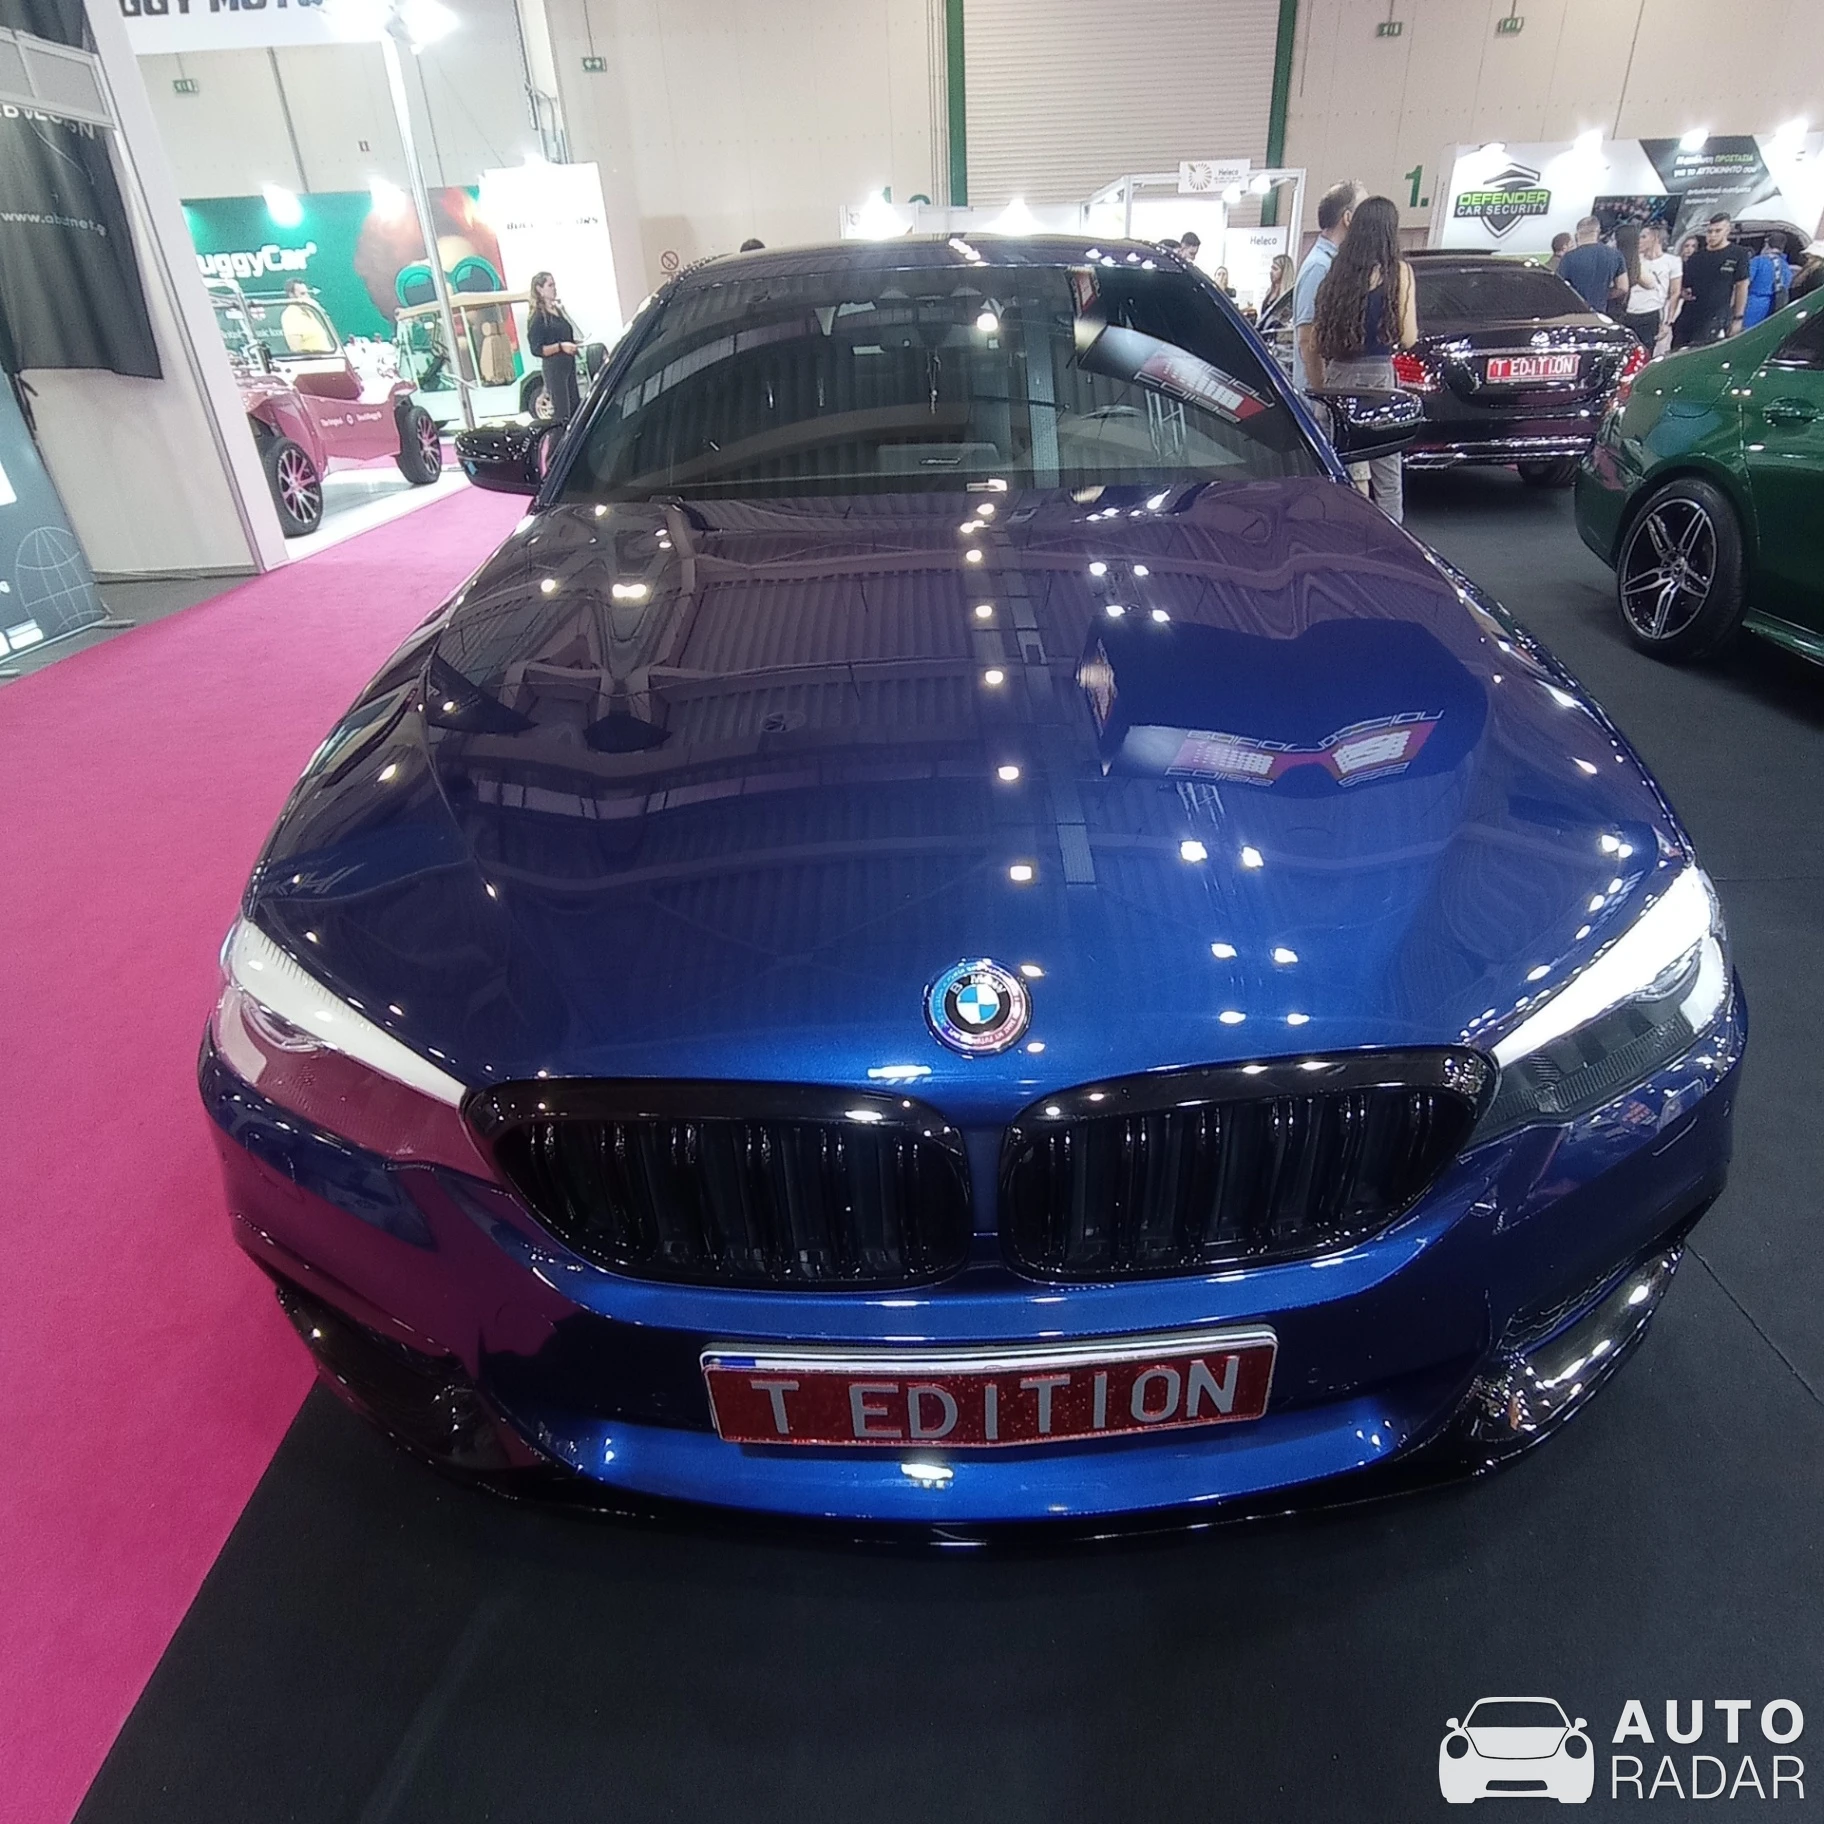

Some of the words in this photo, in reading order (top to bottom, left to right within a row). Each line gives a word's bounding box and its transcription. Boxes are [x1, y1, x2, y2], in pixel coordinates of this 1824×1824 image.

[1458, 191, 1549, 206] DEFENDER
[1457, 205, 1482, 216] CAR
[1485, 203, 1548, 216] SECURITY
[1250, 235, 1278, 246] Heleco
[1510, 356, 1574, 376] EDITION
[750, 1380, 799, 1434] T
[848, 1355, 1240, 1440] EDITION
